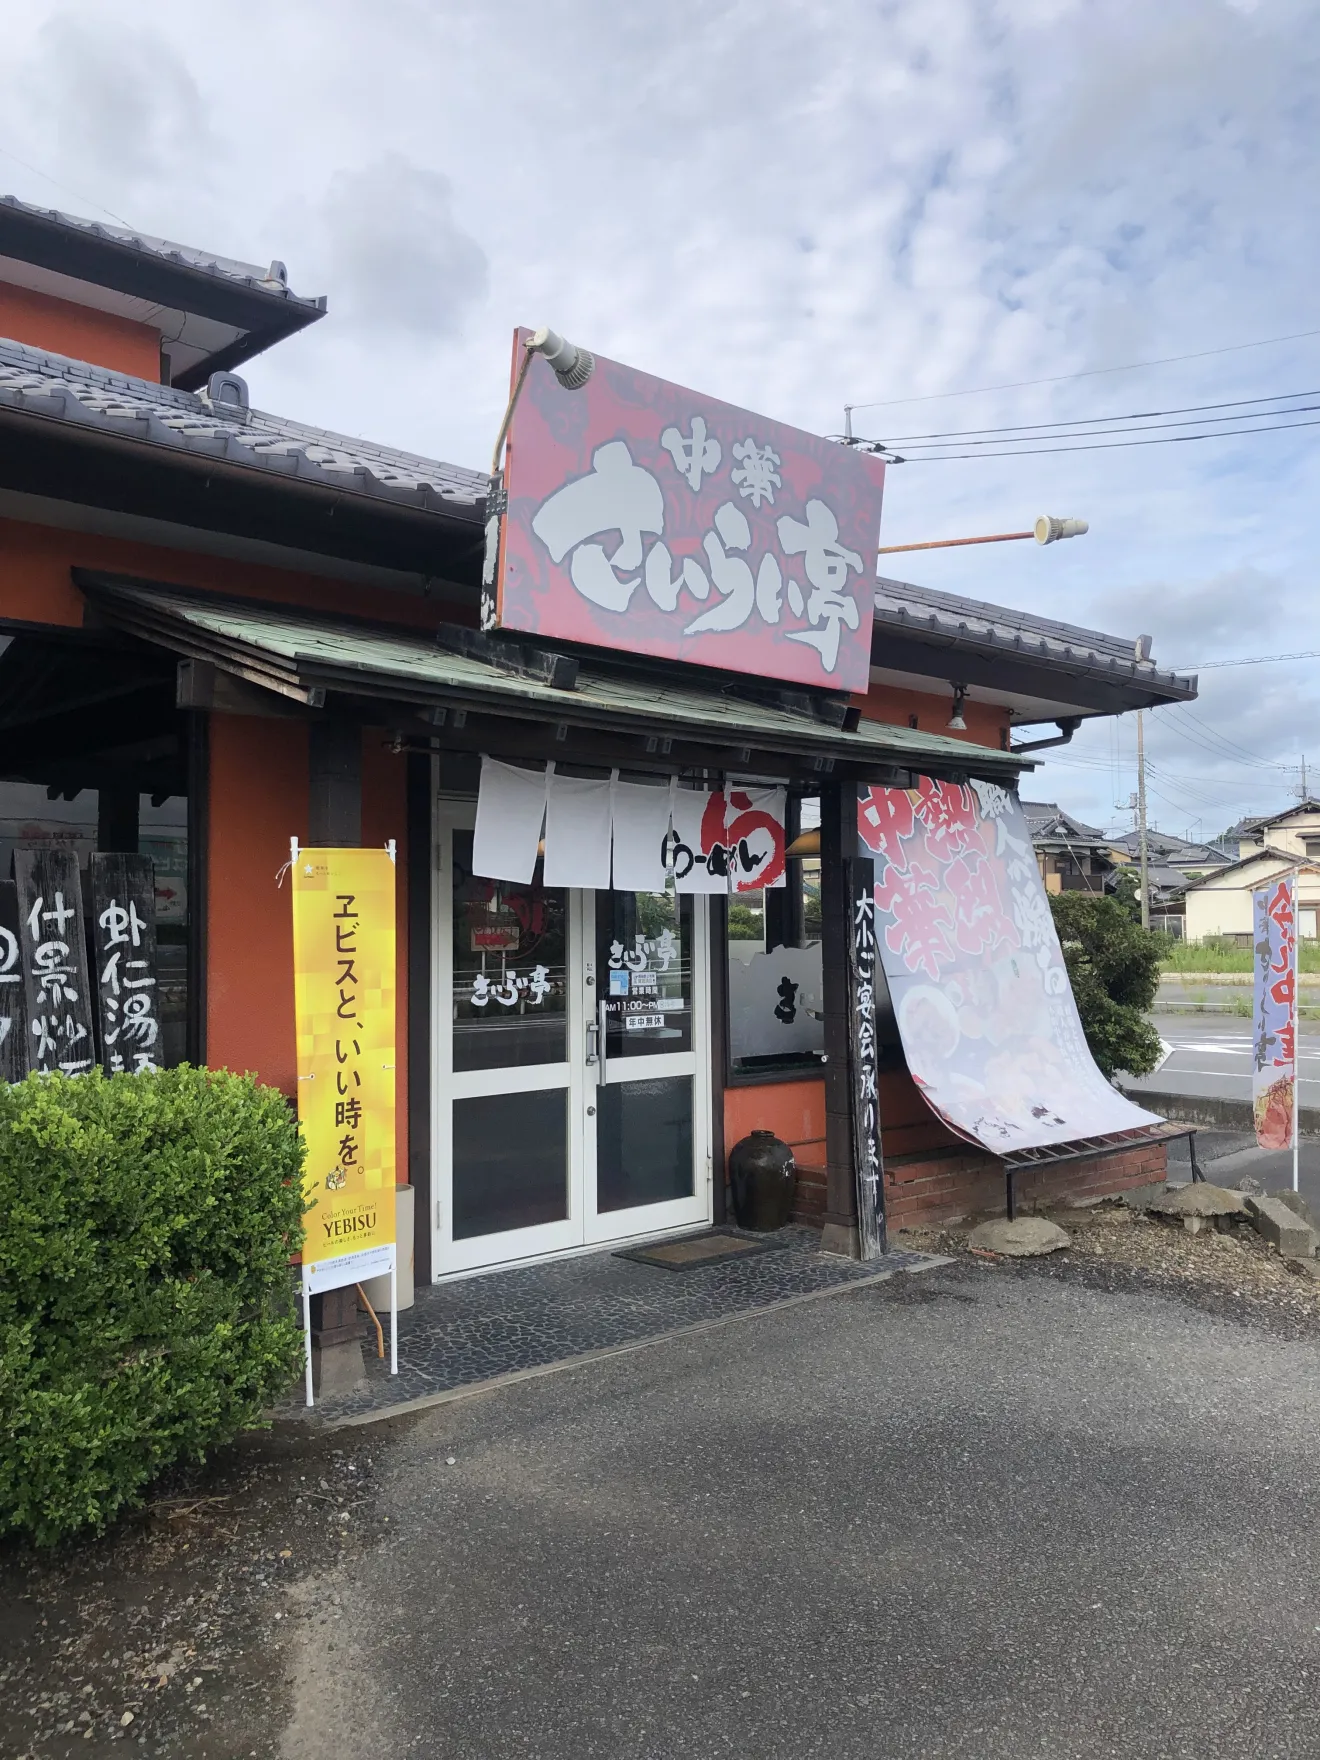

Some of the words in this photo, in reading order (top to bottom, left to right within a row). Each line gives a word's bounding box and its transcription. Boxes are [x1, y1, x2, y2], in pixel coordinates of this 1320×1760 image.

[661, 416, 781, 508] 中華
[857, 783, 956, 983] 中華
[632, 986, 658, 995] 営業時間
[629, 1016, 661, 1027] 年中無休
[321, 1210, 341, 1221] Color
[341, 1207, 357, 1217] Your
[357, 1202, 377, 1213] Time!
[323, 1212, 377, 1238] YEBISU
